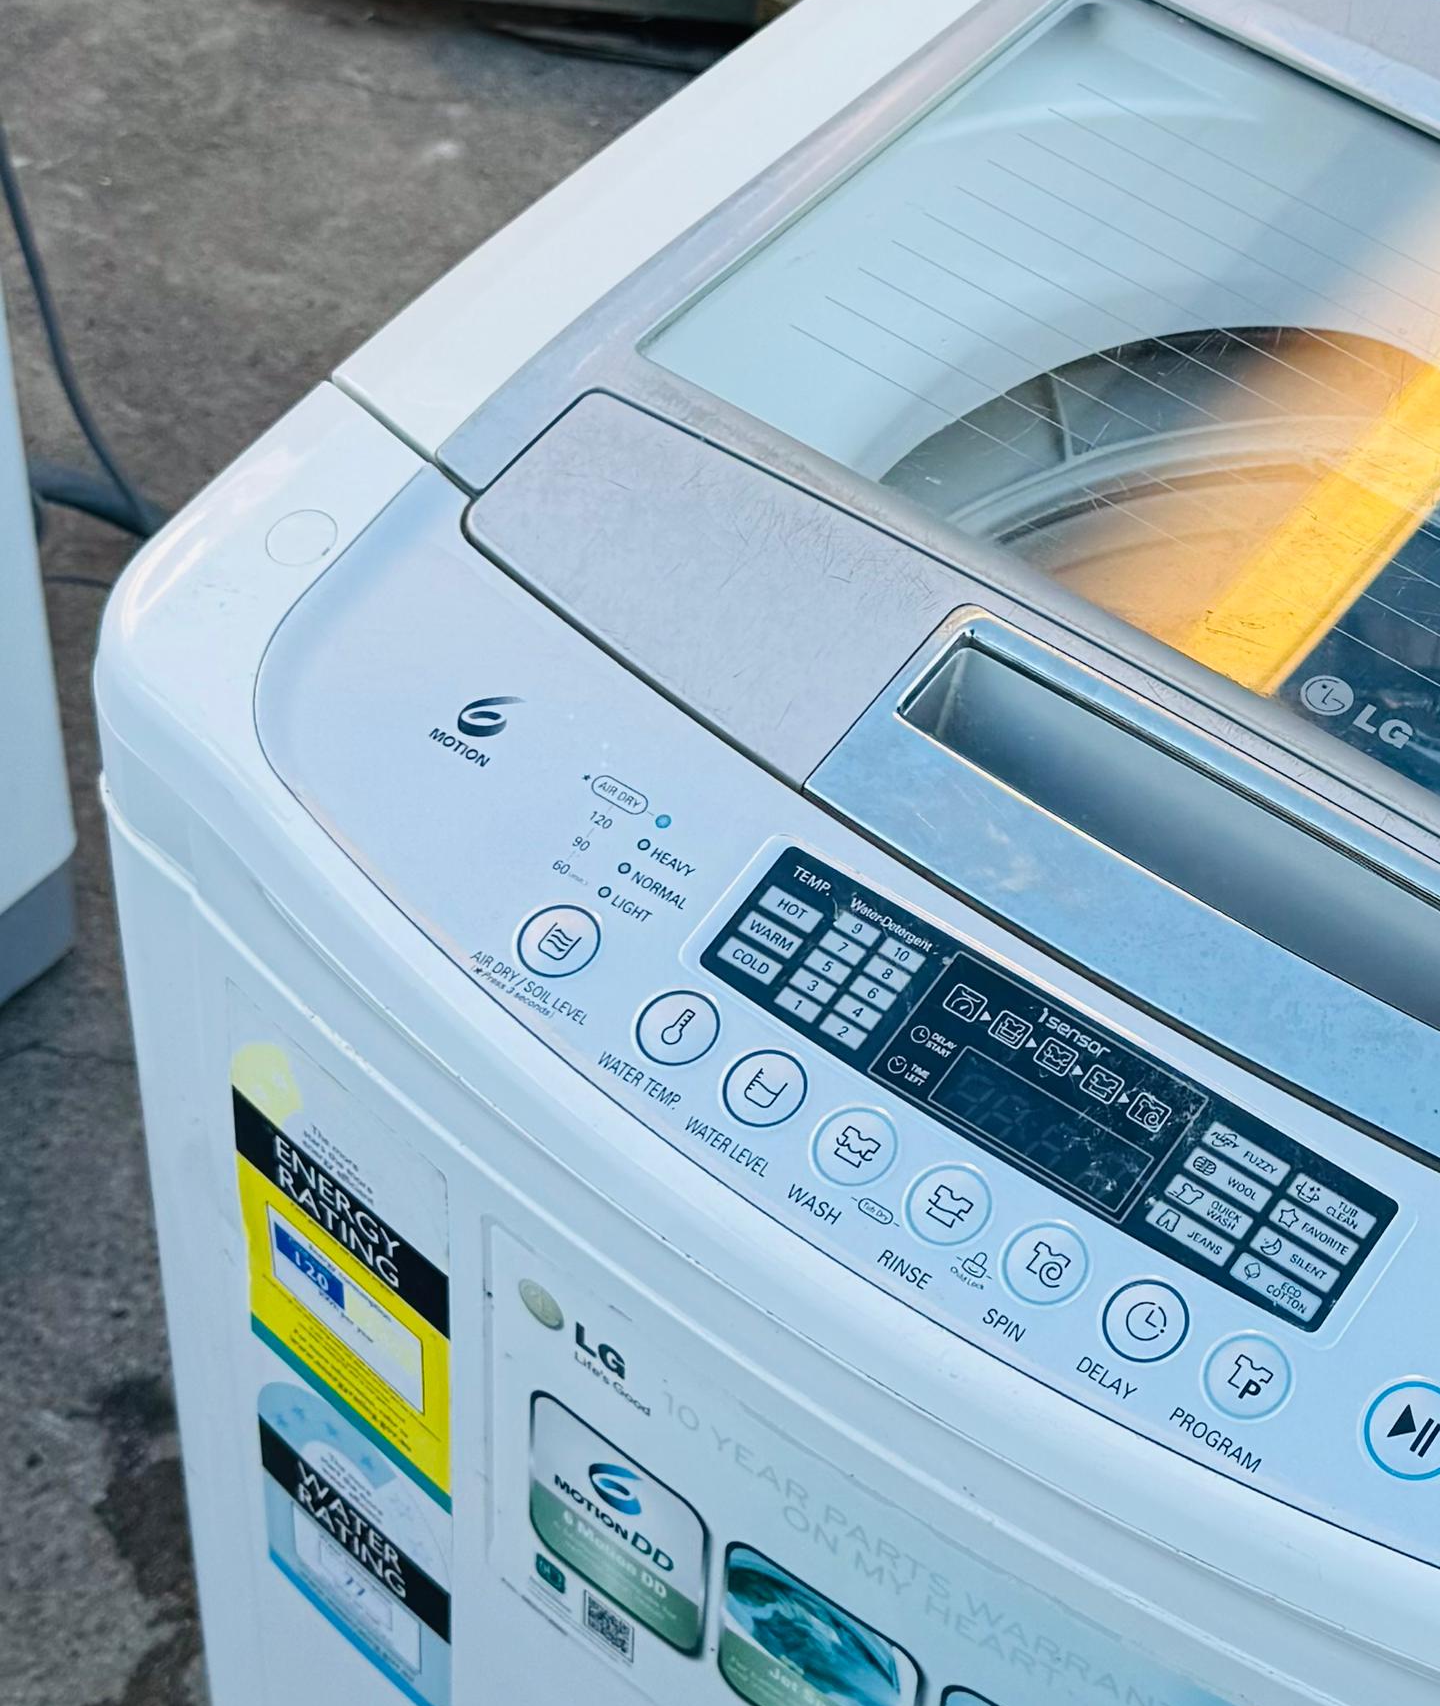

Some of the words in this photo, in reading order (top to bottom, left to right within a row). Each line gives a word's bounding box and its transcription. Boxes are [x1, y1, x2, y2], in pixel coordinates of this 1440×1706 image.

[1353, 704, 1413, 749] LG
[428, 727, 491, 768] MOTION
[597, 781, 618, 796] AIR
[617, 791, 642, 808] DRY
[589, 810, 613, 829] 120
[572, 836, 591, 852] 90
[552, 859, 571, 875] 60
[650, 847, 696, 877] HEAVY
[630, 871, 688, 910] NORMAL
[792, 864, 832, 897] TEMP.
[610, 894, 653, 923] LIGHT
[777, 897, 808, 920] HOT
[749, 918, 796, 952] WARM
[851, 922, 864, 935] 9
[836, 942, 849, 953] 7
[893, 945, 910, 962] 10
[731, 947, 770, 976] COLD
[821, 959, 835, 973] 5
[881, 967, 894, 980] 8
[470, 950, 494, 968] AIR
[492, 961, 520, 982] DRY
[523, 980, 552, 1004] SOIL
[551, 997, 588, 1026] LEVEL
[806, 979, 819, 993] 3
[866, 987, 880, 1000] 6
[793, 999, 803, 1011] 1
[852, 1006, 865, 1018] 4
[836, 1025, 850, 1038] 2
[930, 1031, 958, 1051] DELAY
[924, 1041, 952, 1059] START
[597, 1051, 645, 1088] WATER
[643, 1076, 682, 1110] TEMP.
[904, 1072, 926, 1087] LEFT
[910, 1063, 930, 1078] TIME
[685, 1115, 732, 1154] WATER
[729, 1143, 770, 1178] LEVEL
[1242, 1150, 1279, 1175] FUZZY
[274, 1134, 400, 1258] ENERGY
[1226, 1175, 1257, 1201] WOOL
[787, 1183, 843, 1226] WASH
[1210, 1199, 1242, 1224] QUICK
[1326, 1206, 1359, 1230] CLEAN
[278, 1164, 400, 1288] RATING
[1206, 1209, 1237, 1231] WASH
[1186, 1230, 1223, 1256] JEANS
[1301, 1222, 1350, 1256] FAVORITE
[876, 1249, 933, 1290] RINSE
[1289, 1253, 1328, 1280] SILENT
[1265, 1284, 1308, 1315] COTTON
[1280, 1281, 1303, 1298] ECO
[982, 1308, 1027, 1343] SPIN
[575, 1321, 626, 1380] LG
[574, 1350, 610, 1386] Life's
[612, 1380, 652, 1417] Good
[1075, 1356, 1139, 1400] DELAY
[1169, 1406, 1262, 1473] PROGRAM
[297, 1460, 403, 1575] WATER
[554, 1474, 629, 1541] MOTION
[710, 1425, 809, 1509] YEAR
[824, 1503, 952, 1598] PARTS
[297, 1482, 407, 1599] RATING
[783, 1505, 839, 1555] ON
[854, 1549, 912, 1596] MY
[768, 1667, 798, 1693] Jet
